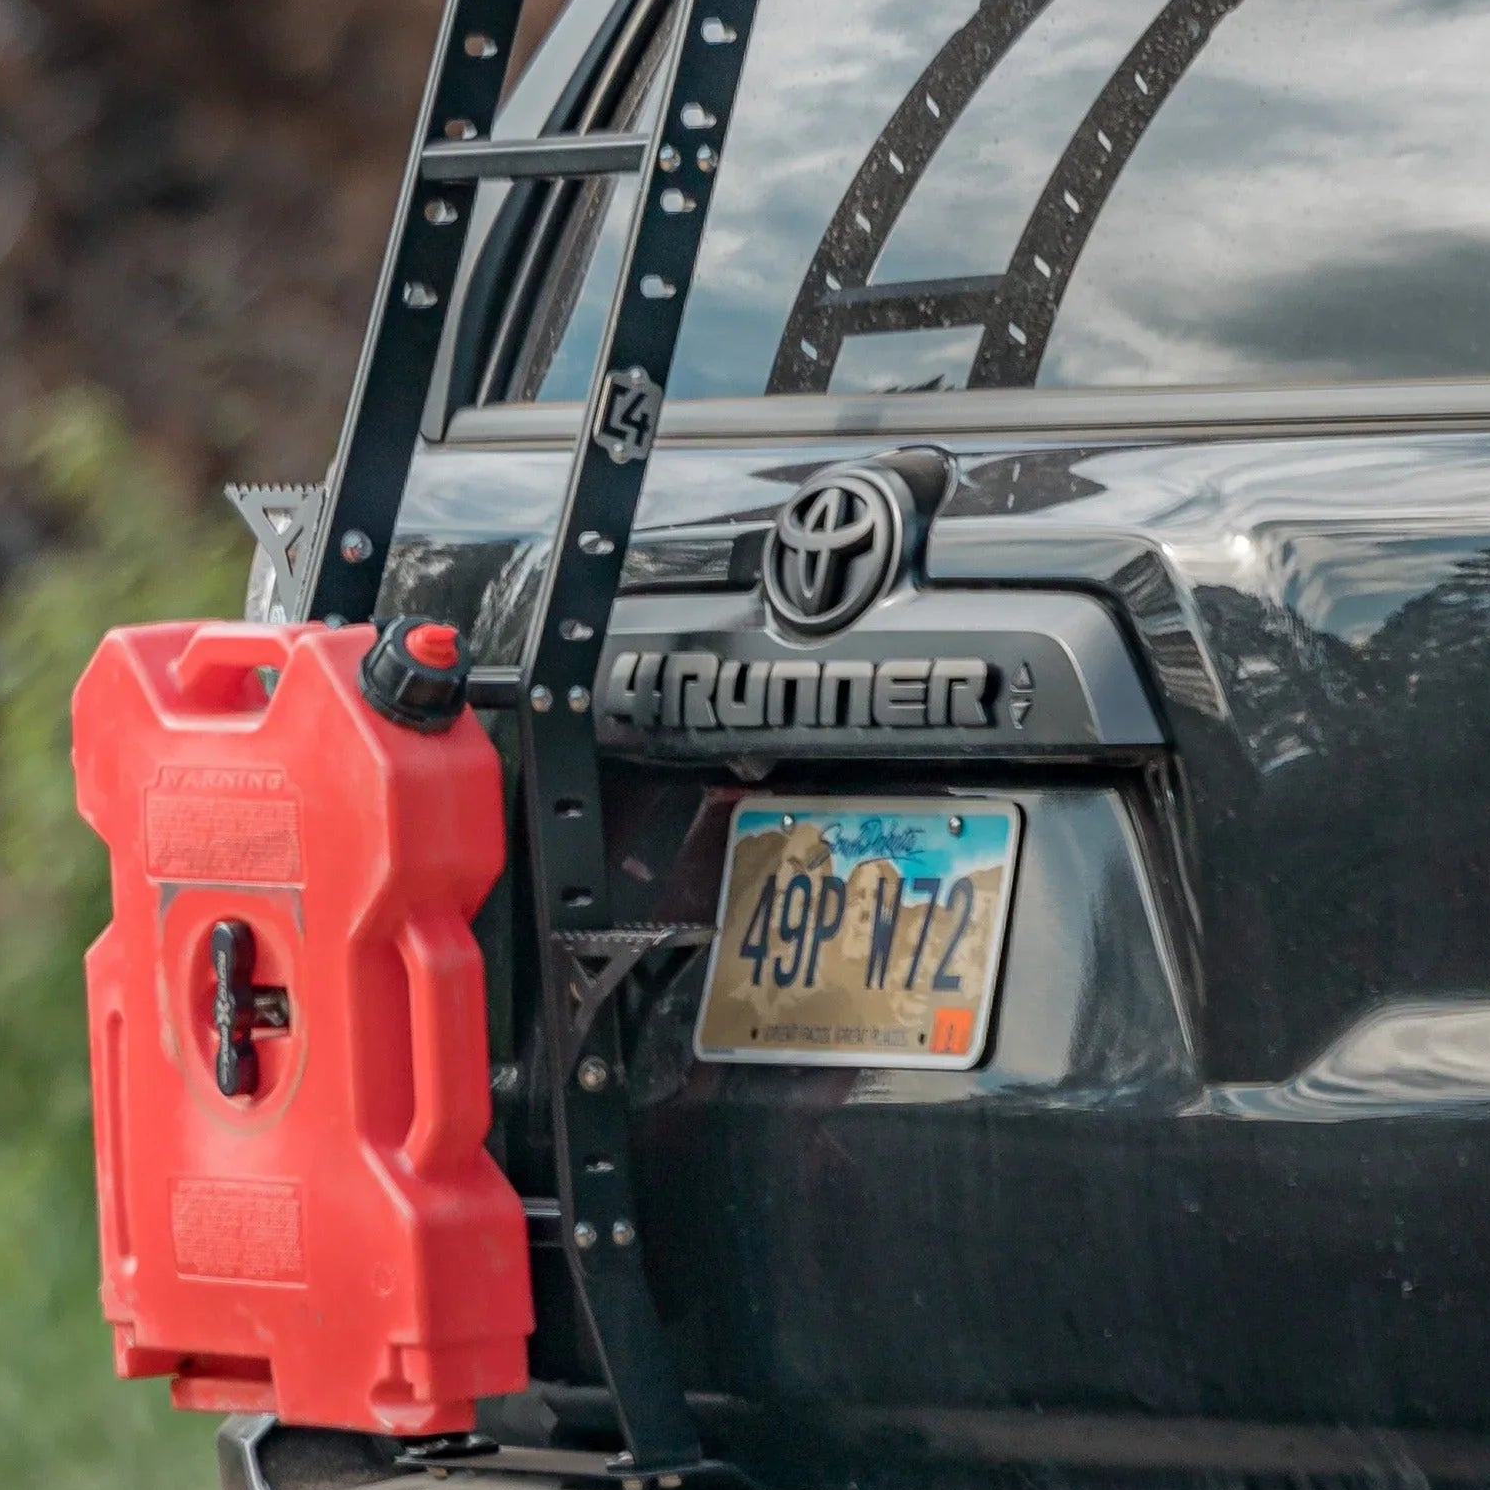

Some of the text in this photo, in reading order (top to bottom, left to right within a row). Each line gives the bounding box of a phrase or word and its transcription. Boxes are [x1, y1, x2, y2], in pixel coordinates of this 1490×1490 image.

[609, 651, 989, 728] 4RUNNER
[740, 874, 974, 992] 49P W72
